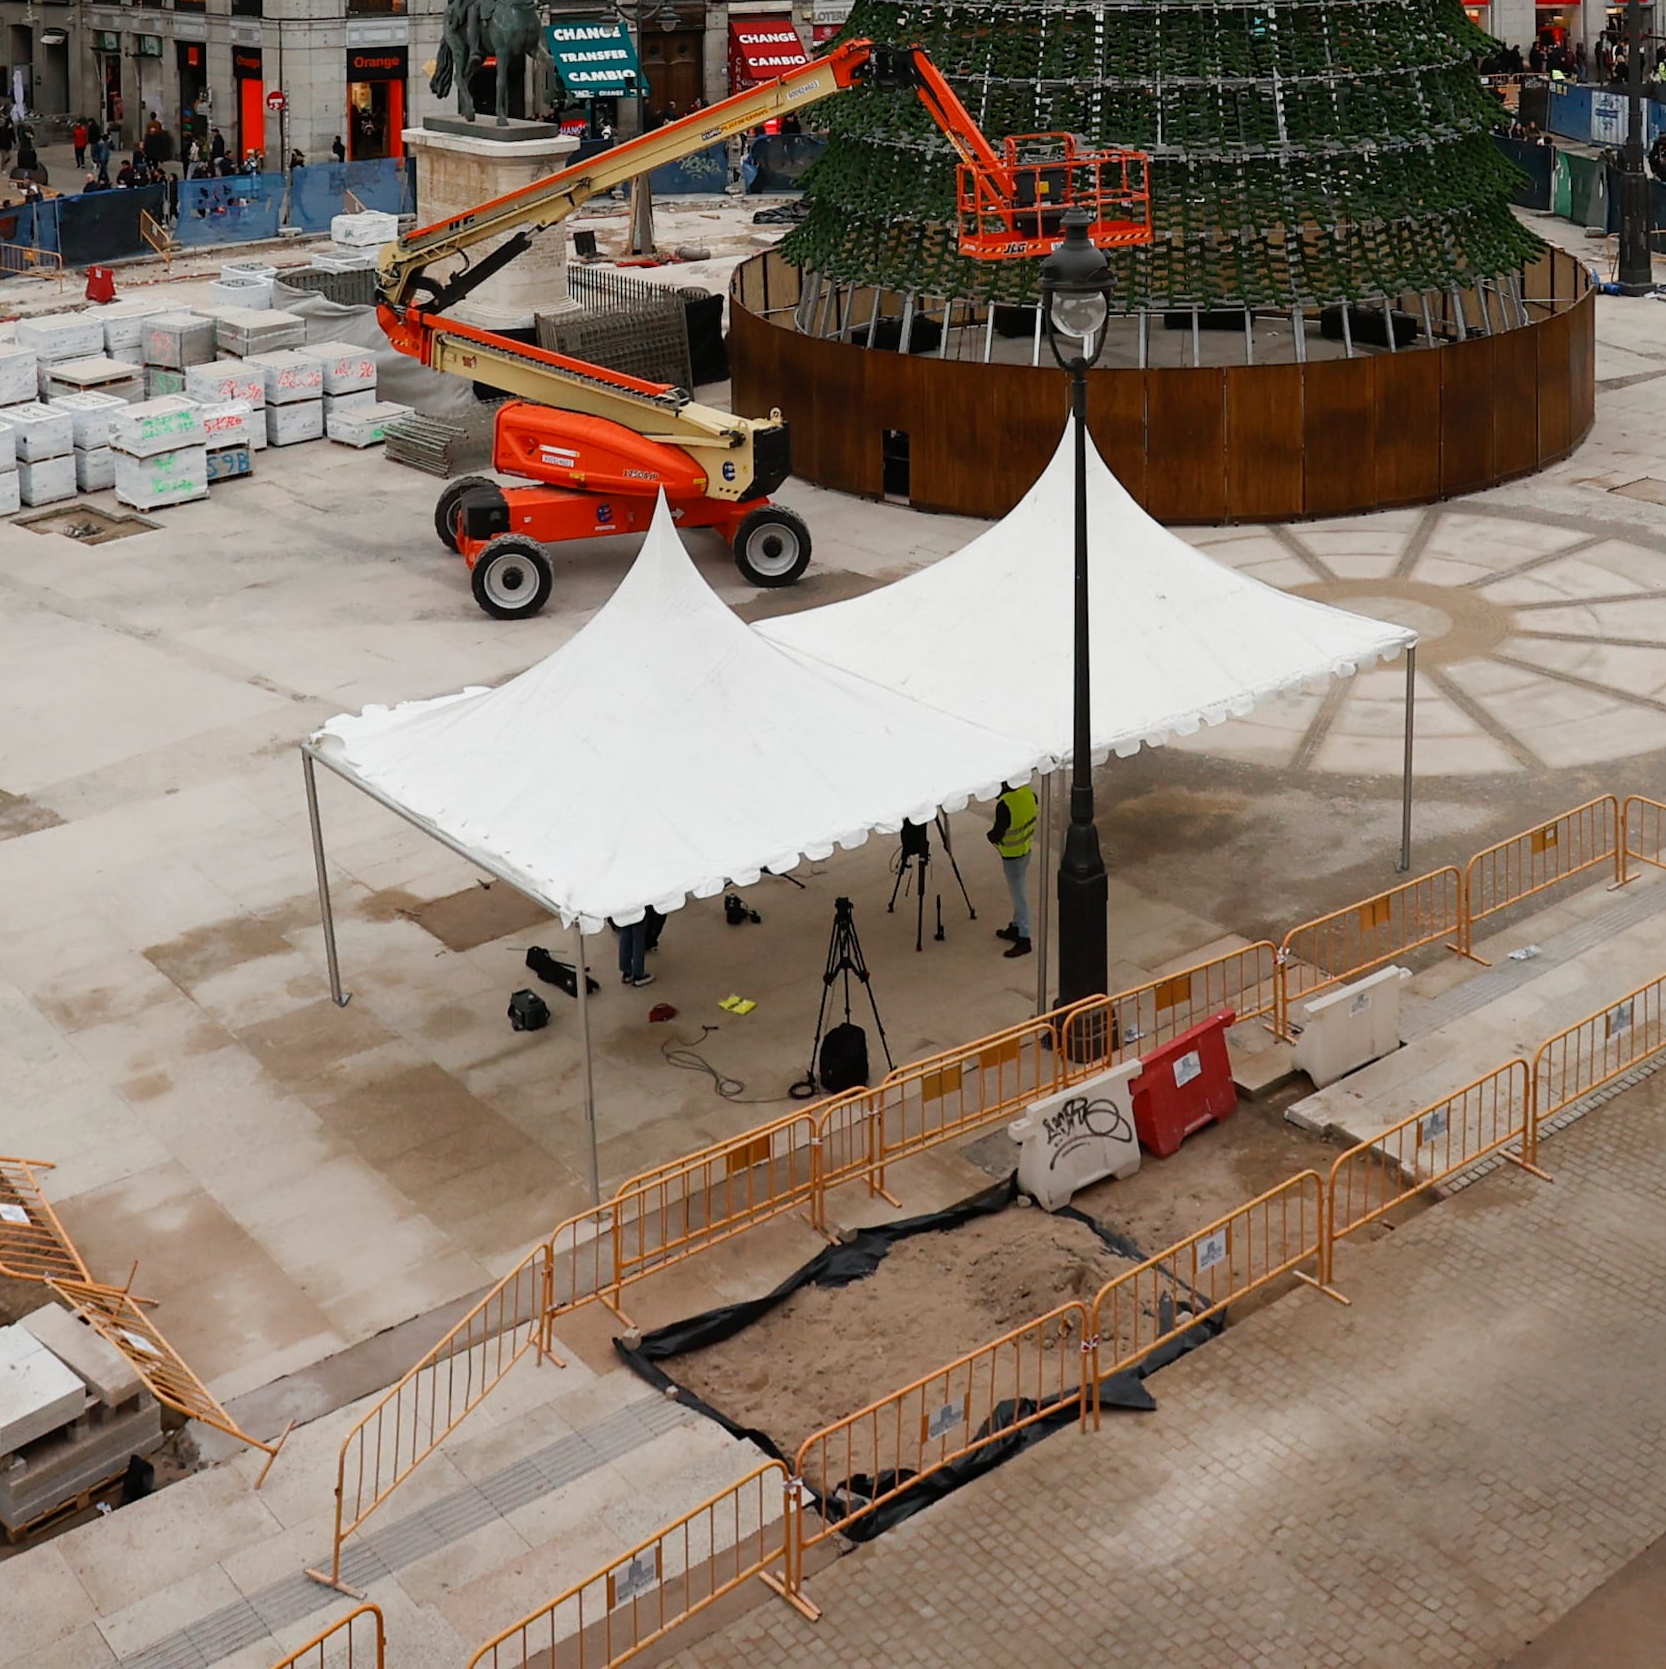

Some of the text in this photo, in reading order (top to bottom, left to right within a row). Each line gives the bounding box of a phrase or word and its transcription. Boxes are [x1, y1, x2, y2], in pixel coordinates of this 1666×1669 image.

[738, 32, 798, 44] CHANGE
[352, 55, 401, 69] Orange
[559, 49, 628, 63] TRANSFER
[748, 55, 807, 67] CAMBIO
[568, 69, 637, 82] CAMBIO
